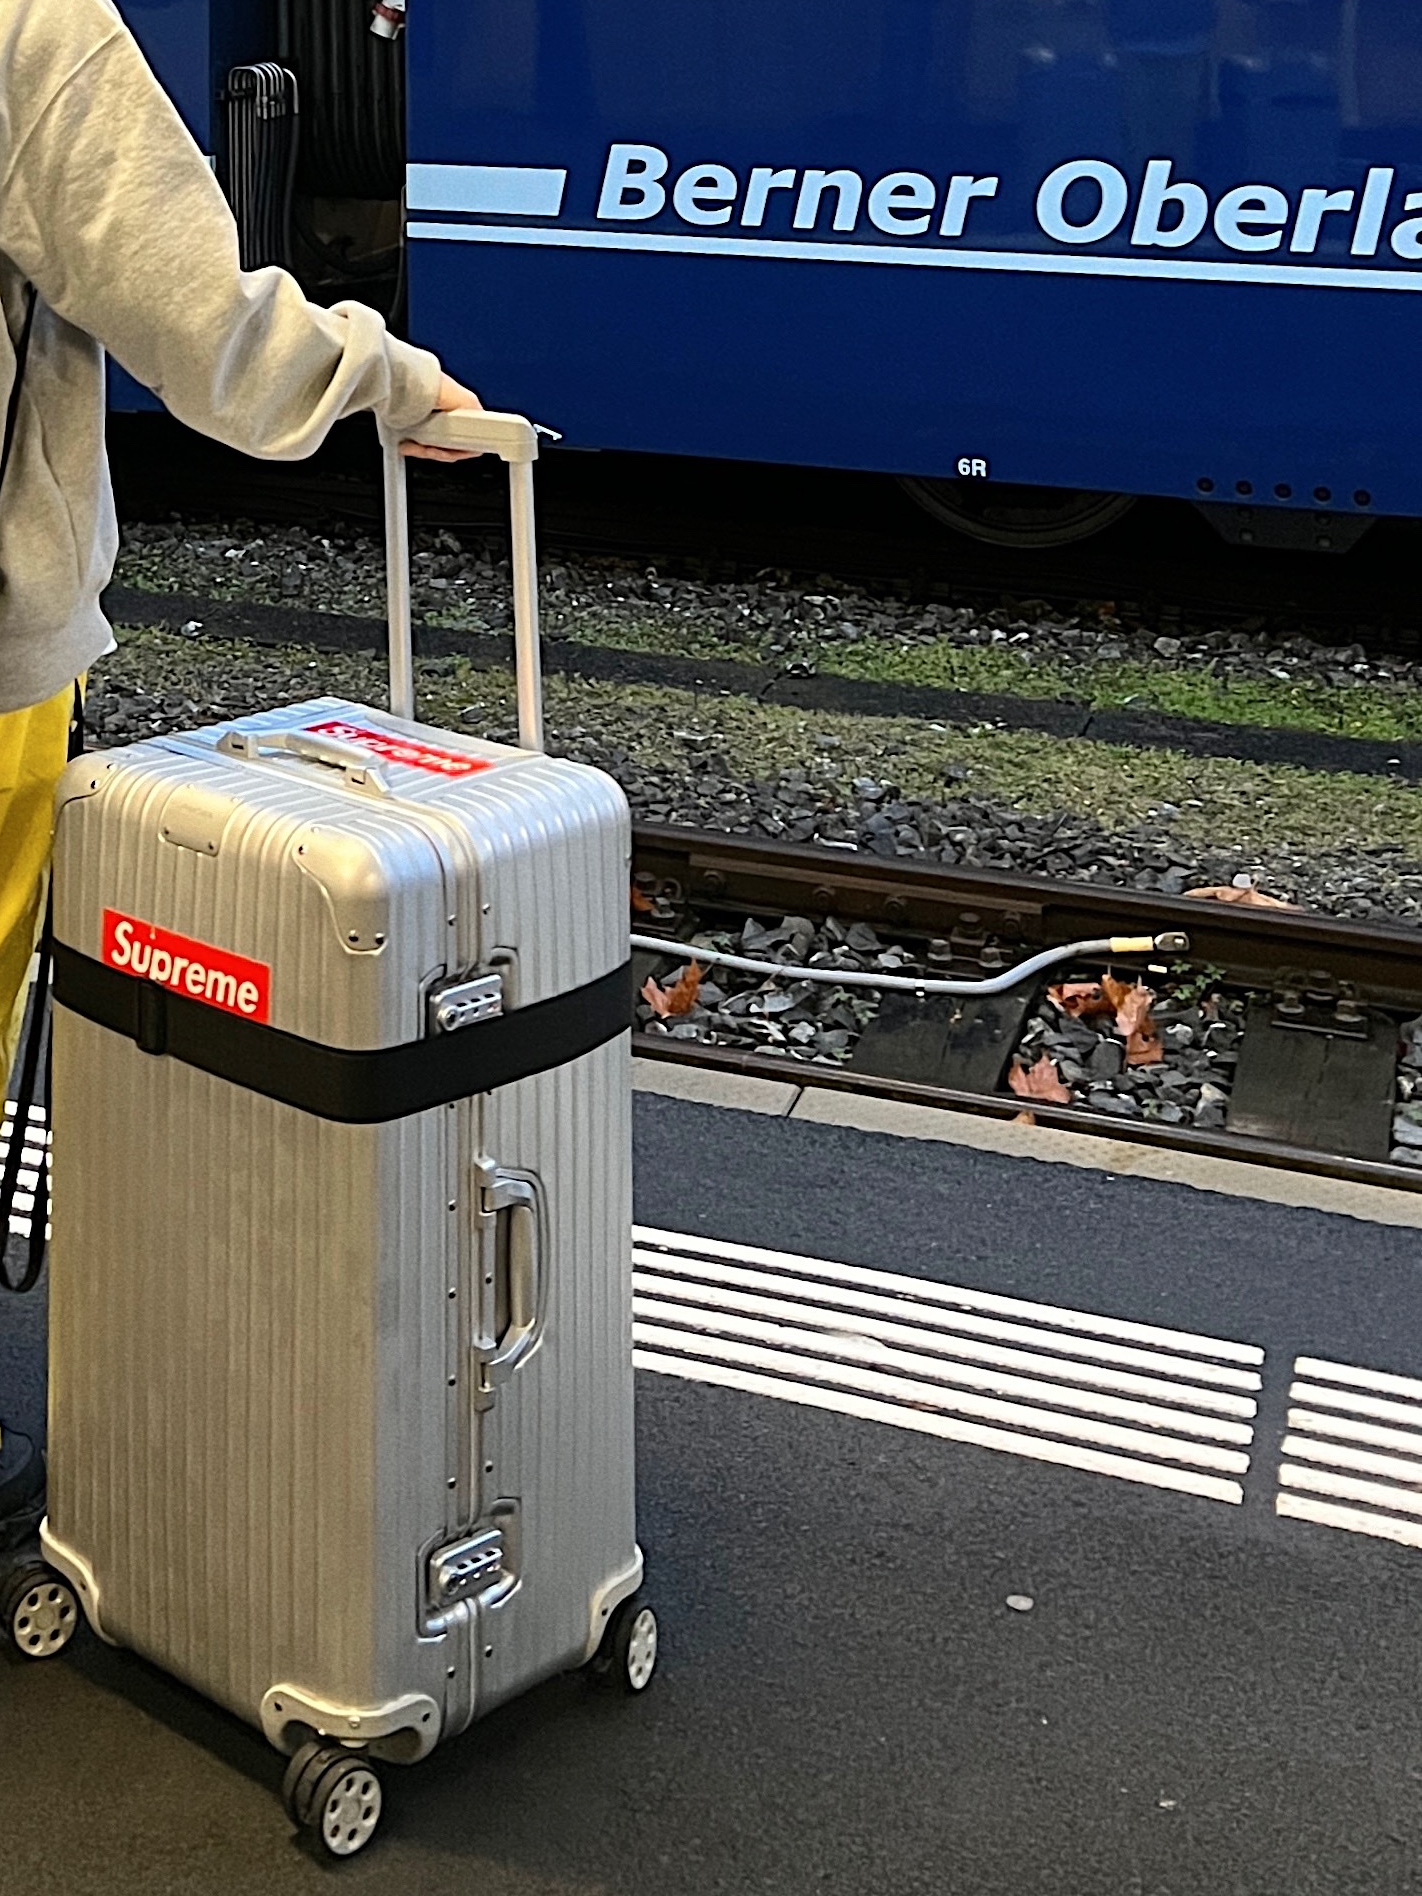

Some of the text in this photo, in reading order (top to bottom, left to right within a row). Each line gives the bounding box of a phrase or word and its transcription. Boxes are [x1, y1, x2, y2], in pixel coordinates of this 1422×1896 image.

[596, 143, 999, 237] Berner
[957, 457, 987, 477] 6R
[111, 920, 259, 1014] Supreme
